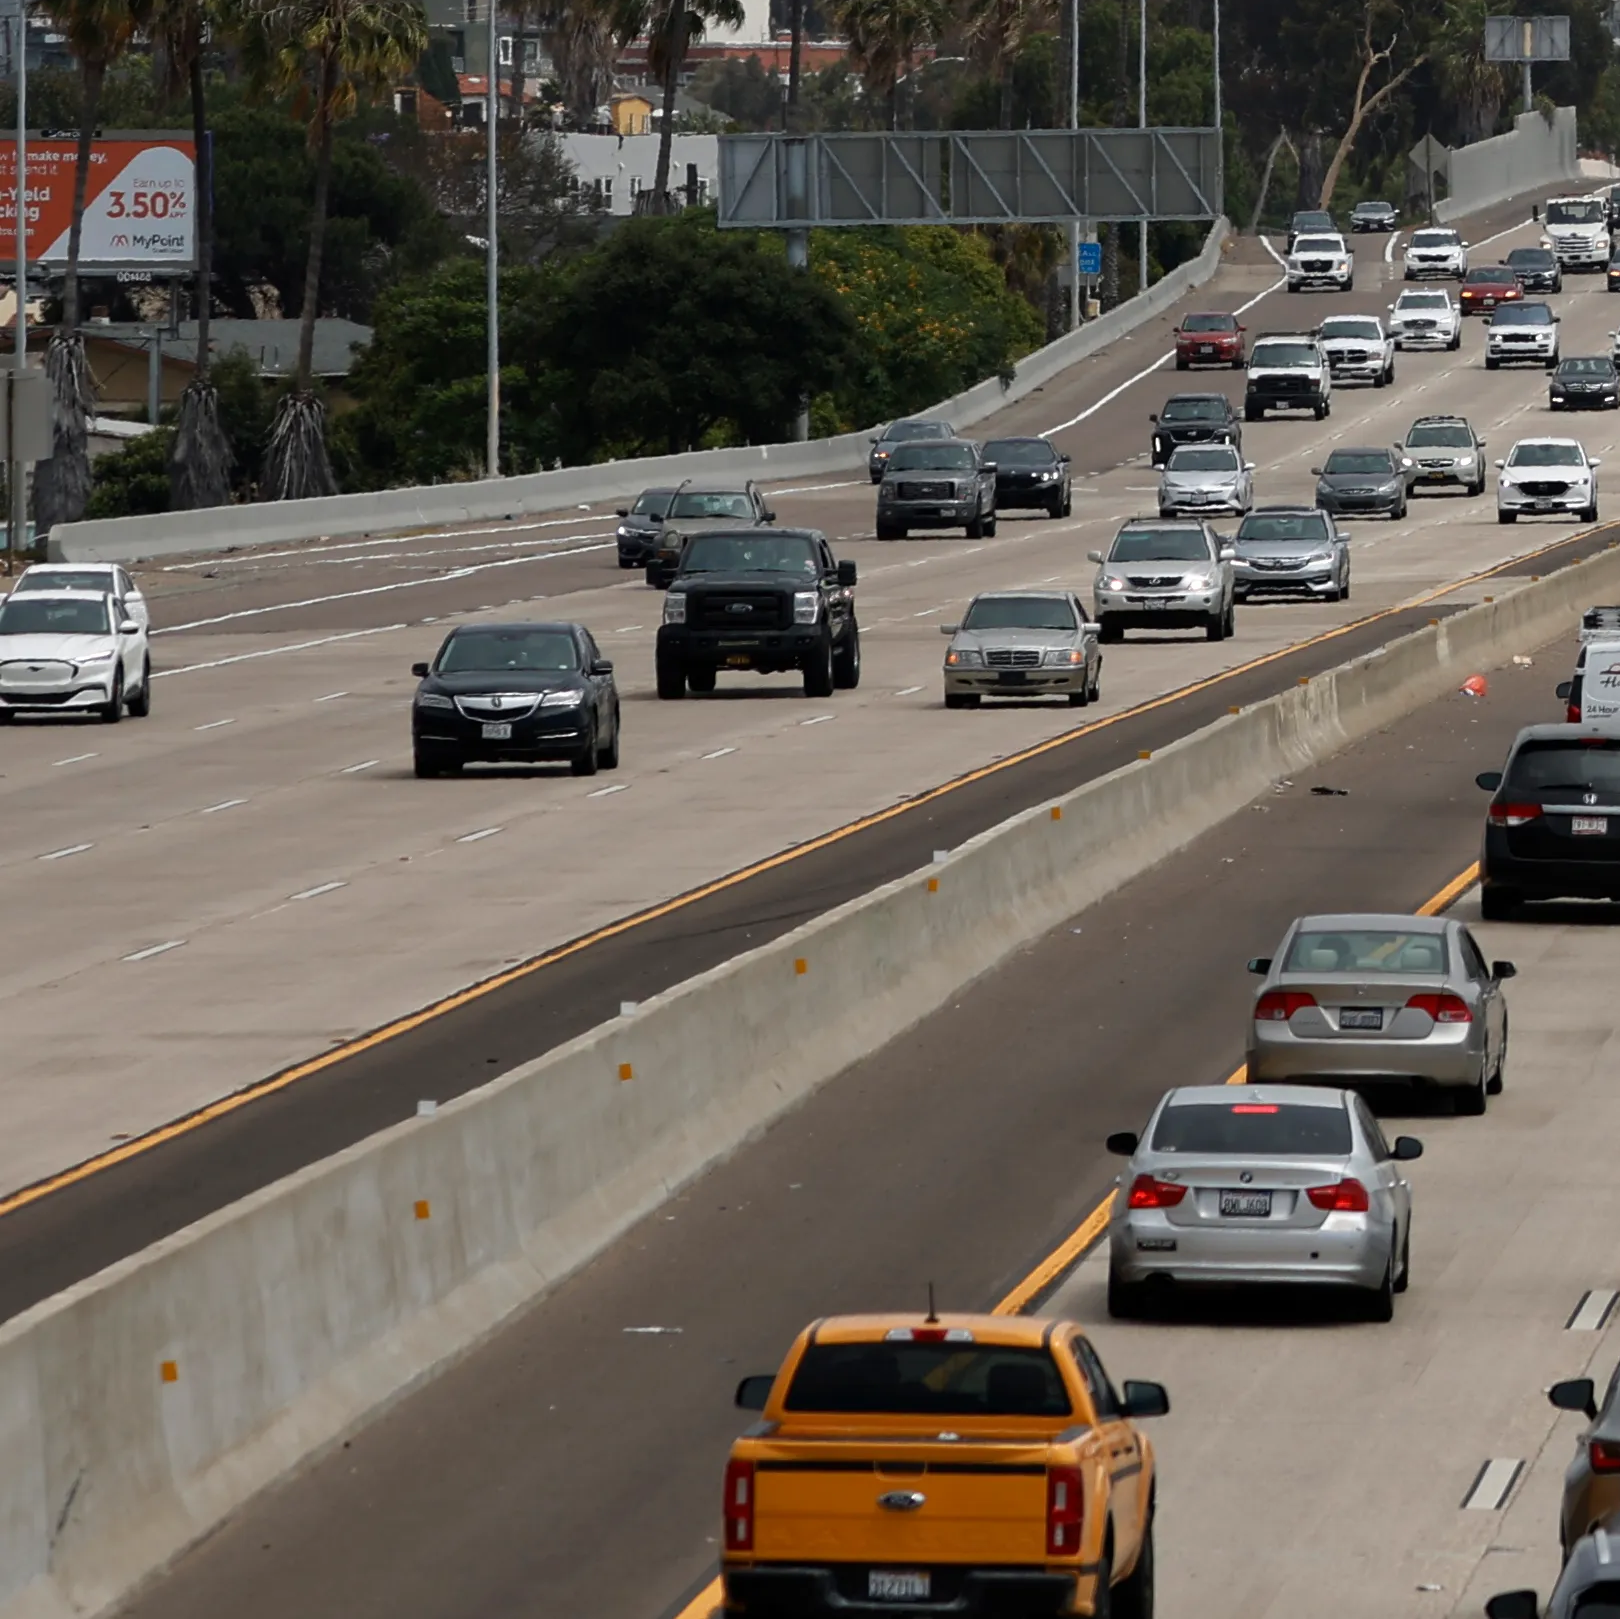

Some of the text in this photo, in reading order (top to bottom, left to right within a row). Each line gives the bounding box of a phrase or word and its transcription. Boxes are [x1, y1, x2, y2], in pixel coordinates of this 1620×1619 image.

[27, 151, 60, 162] make
[63, 152, 108, 164] moey,
[10, 165, 47, 175] send
[133, 179, 156, 188] Earn
[158, 180, 172, 190] up
[106, 191, 187, 219] 3.50%
[133, 234, 184, 249] MyPoint
[1586, 705, 1597, 713] 24
[1598, 705, 1619, 713] Hour
